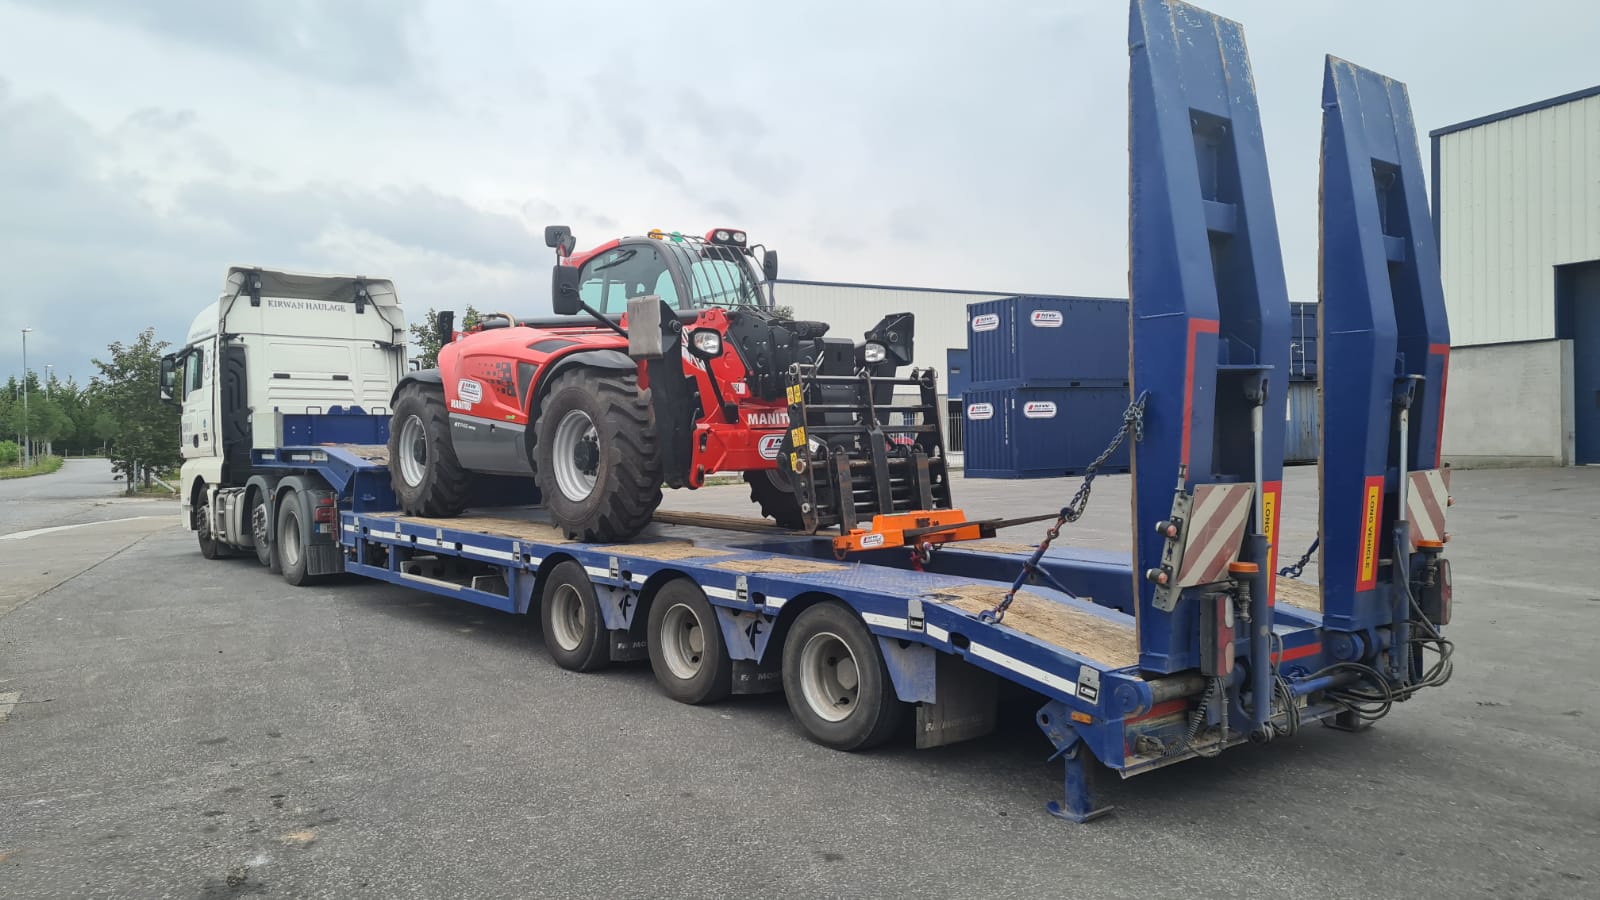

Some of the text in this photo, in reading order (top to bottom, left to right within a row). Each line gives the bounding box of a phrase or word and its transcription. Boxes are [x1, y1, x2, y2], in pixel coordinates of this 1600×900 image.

[267, 300, 346, 312] KIRWAN HAULAGE
[1364, 526, 1374, 569] VEHICLE
